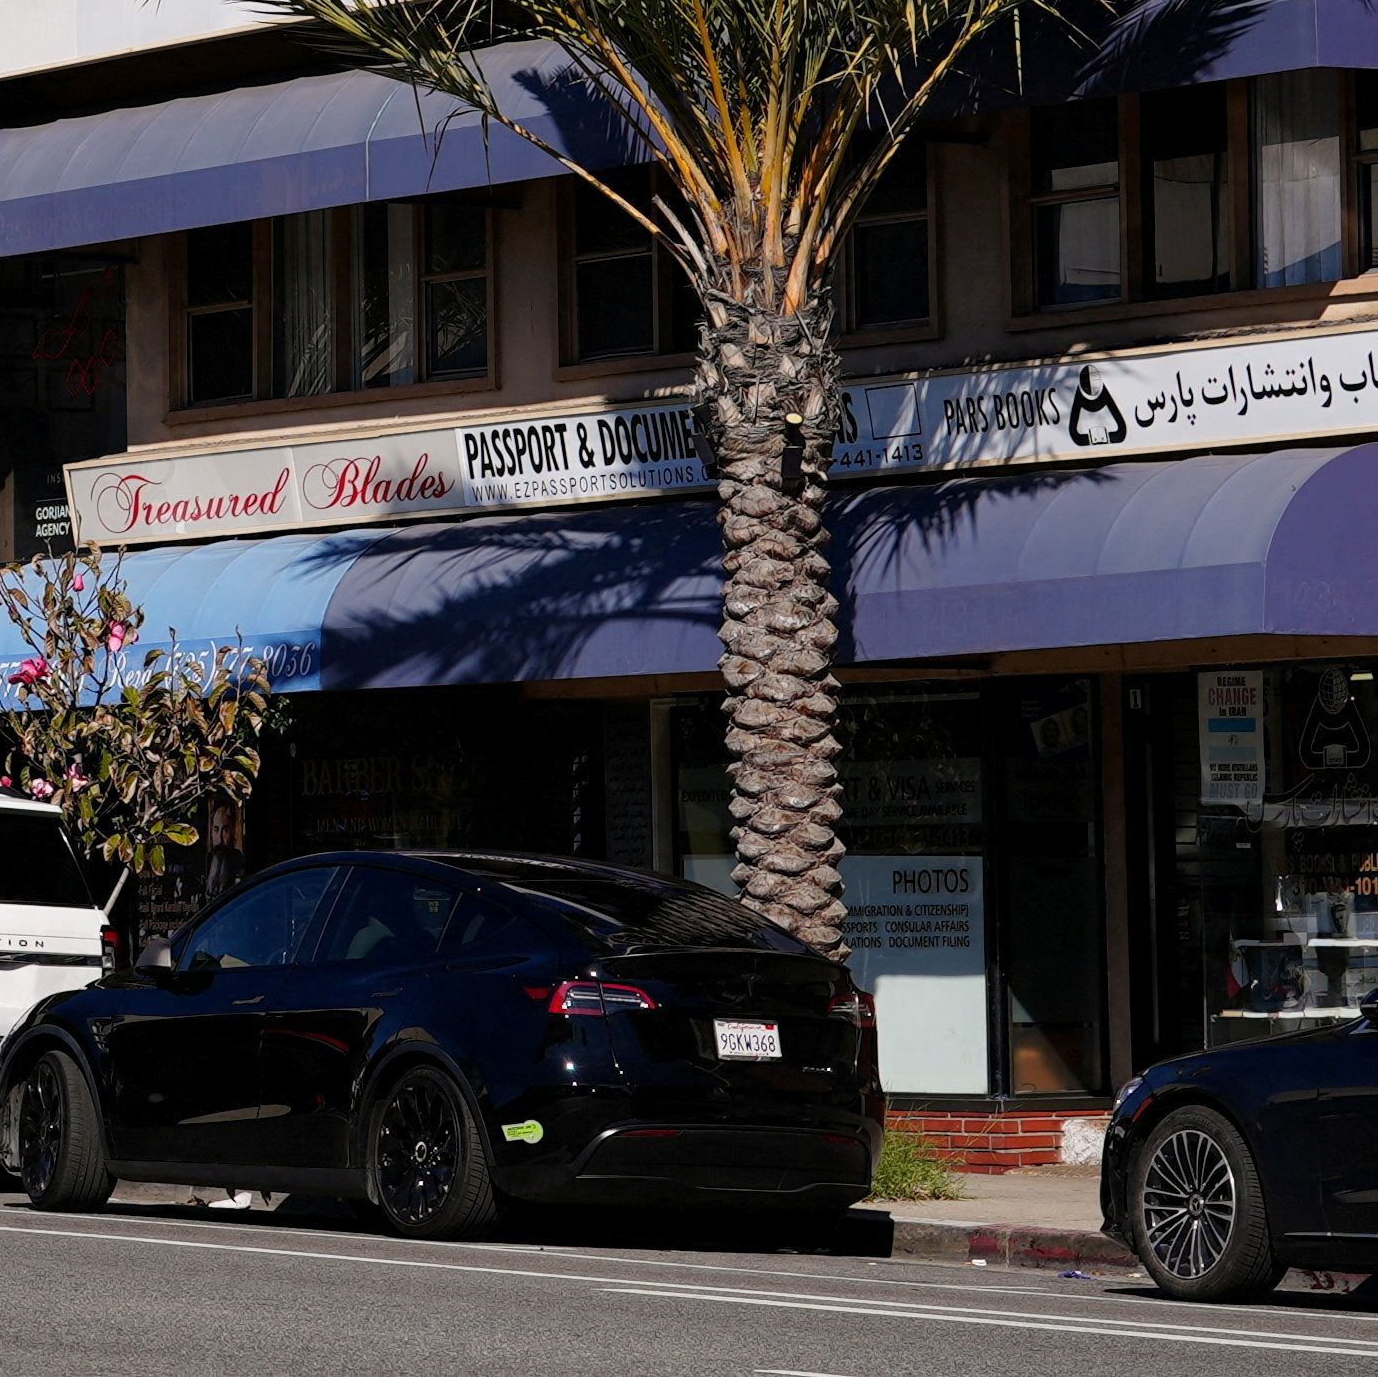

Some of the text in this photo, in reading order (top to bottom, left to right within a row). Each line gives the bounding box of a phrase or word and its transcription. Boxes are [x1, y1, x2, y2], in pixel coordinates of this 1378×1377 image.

[1134, 370, 1196, 428] پارس
[943, 387, 1061, 436] PARS BOOKS
[463, 409, 701, 480] PASSPORT & DOCUME
[833, 443, 924, 468] -441-1413
[90, 452, 456, 534] Treasured Blades
[471, 465, 710, 503] WWW.EZPASSPORTSOLUTIONS.C
[36, 522, 70, 537] AGENCY
[1216, 676, 1246, 687] REGIME
[1208, 687, 1257, 706] CHANGE
[886, 775, 931, 801] VISA
[1209, 782, 1258, 799] MUST GO
[892, 868, 969, 894] PHOTOS
[905, 904, 913, 916] &
[842, 920, 969, 933] SSPORTS CONSULAR AFFAIRS
[888, 935, 939, 948] DOCUMENT
[942, 935, 970, 948] FILING
[720, 1033, 776, 1052] 9GKW368
